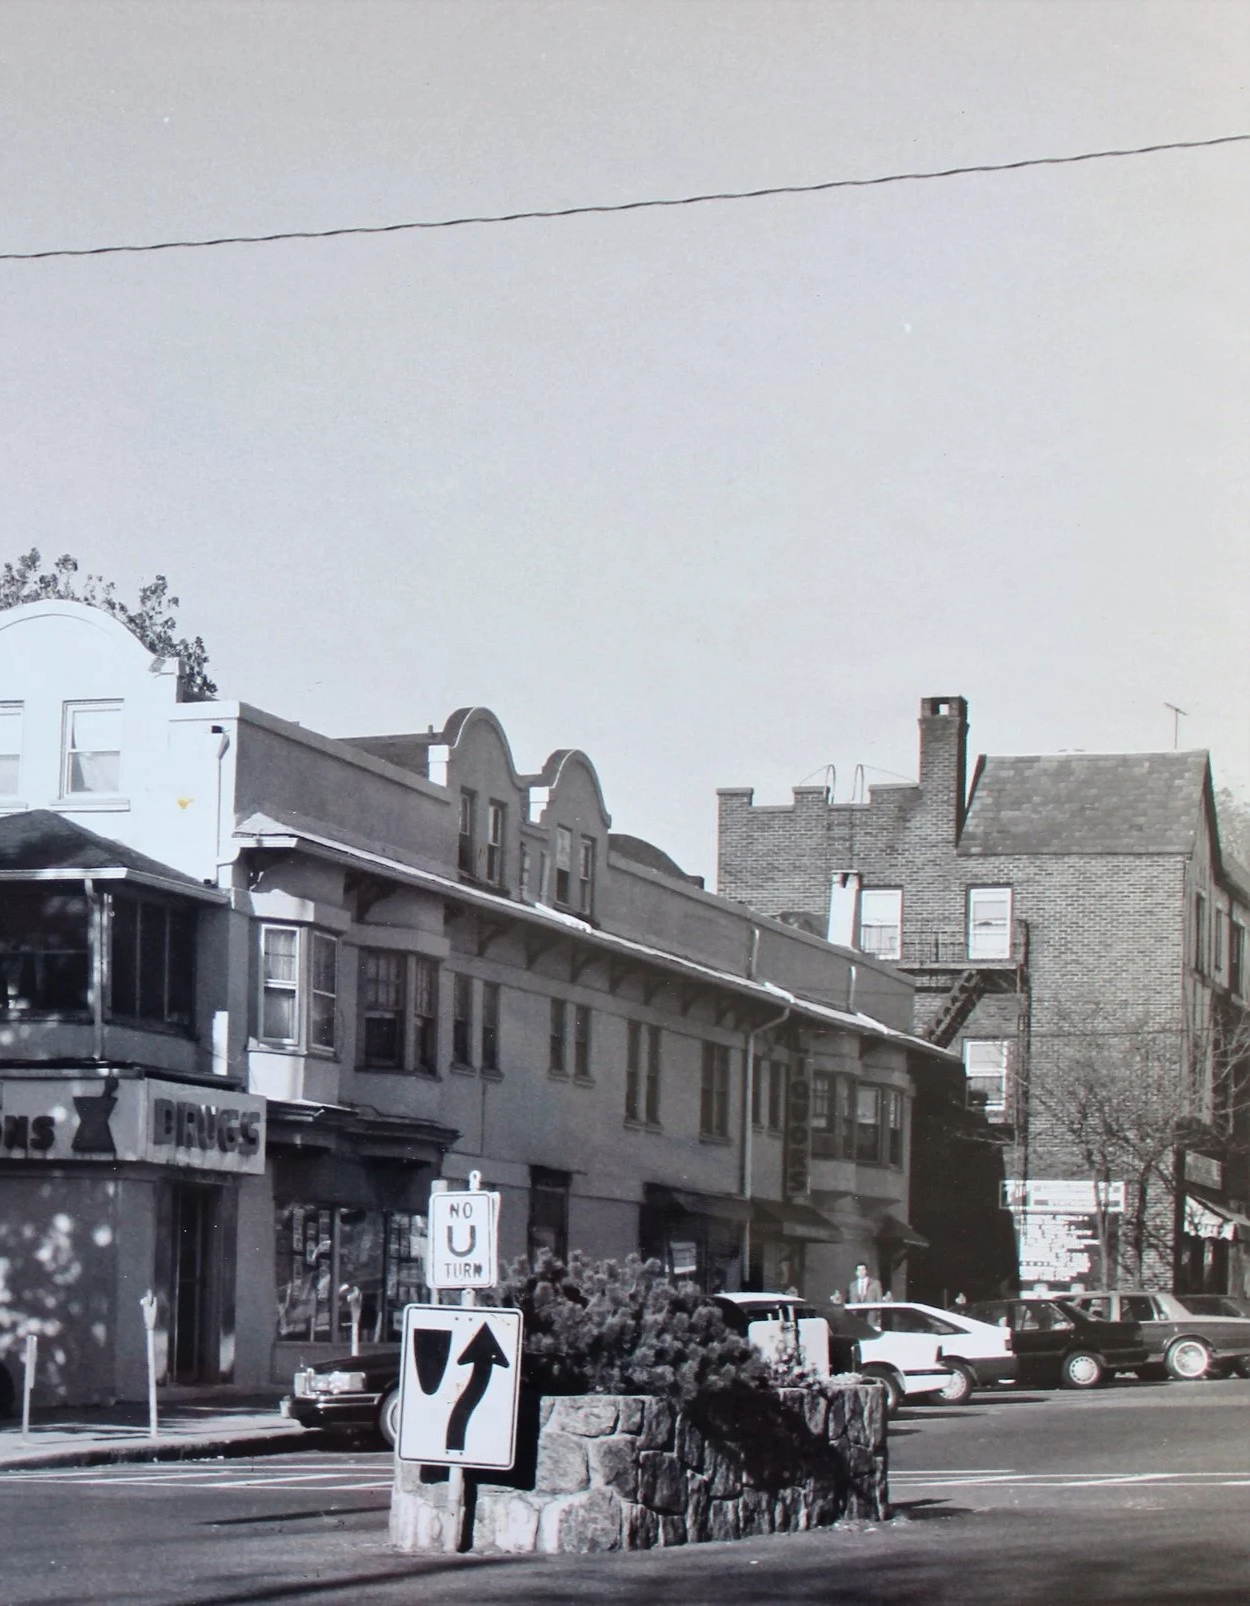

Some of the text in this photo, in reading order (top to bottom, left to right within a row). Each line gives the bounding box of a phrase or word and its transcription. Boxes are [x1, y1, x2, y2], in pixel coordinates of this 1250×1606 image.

[153, 1098, 261, 1156] DRUGS
[449, 1201, 474, 1219] NO
[447, 1224, 477, 1258] U
[444, 1262, 483, 1279] TURN
